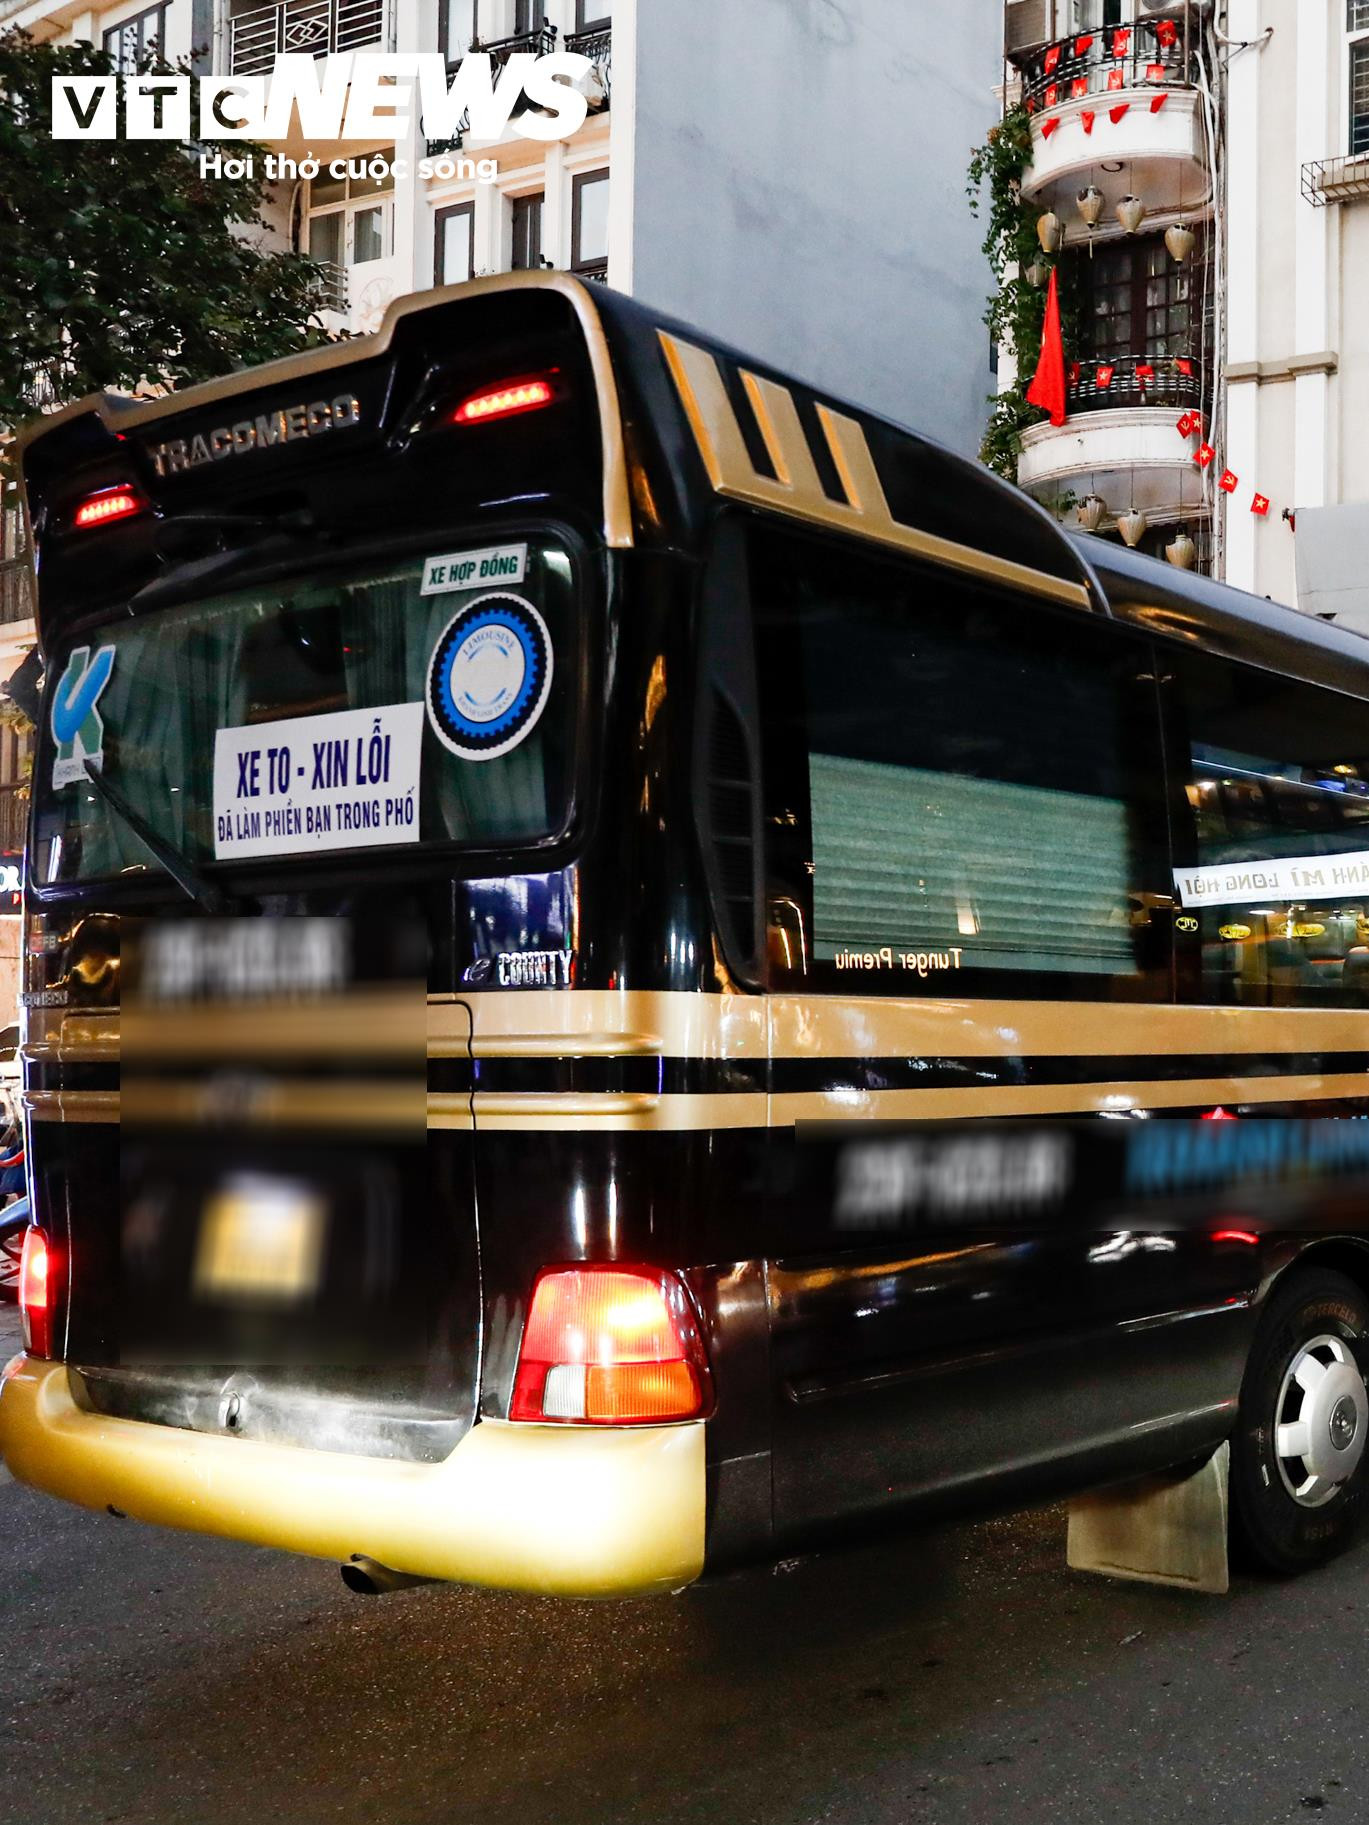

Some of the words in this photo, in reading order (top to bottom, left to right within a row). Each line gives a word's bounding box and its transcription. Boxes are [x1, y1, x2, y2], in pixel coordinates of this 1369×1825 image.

[149, 394, 360, 477] TRACOMECO
[429, 566, 446, 585] XE
[449, 560, 476, 584] HỢP
[237, 750, 261, 798] XE
[268, 746, 290, 795] TO
[312, 739, 350, 790] XIN
[356, 718, 391, 786] LỖI
[237, 806, 261, 840] LÀM
[306, 804, 331, 839] BẠN
[336, 800, 380, 830] TRONG
[386, 786, 416, 826] PHỐ
[499, 949, 573, 986] COUNTY
